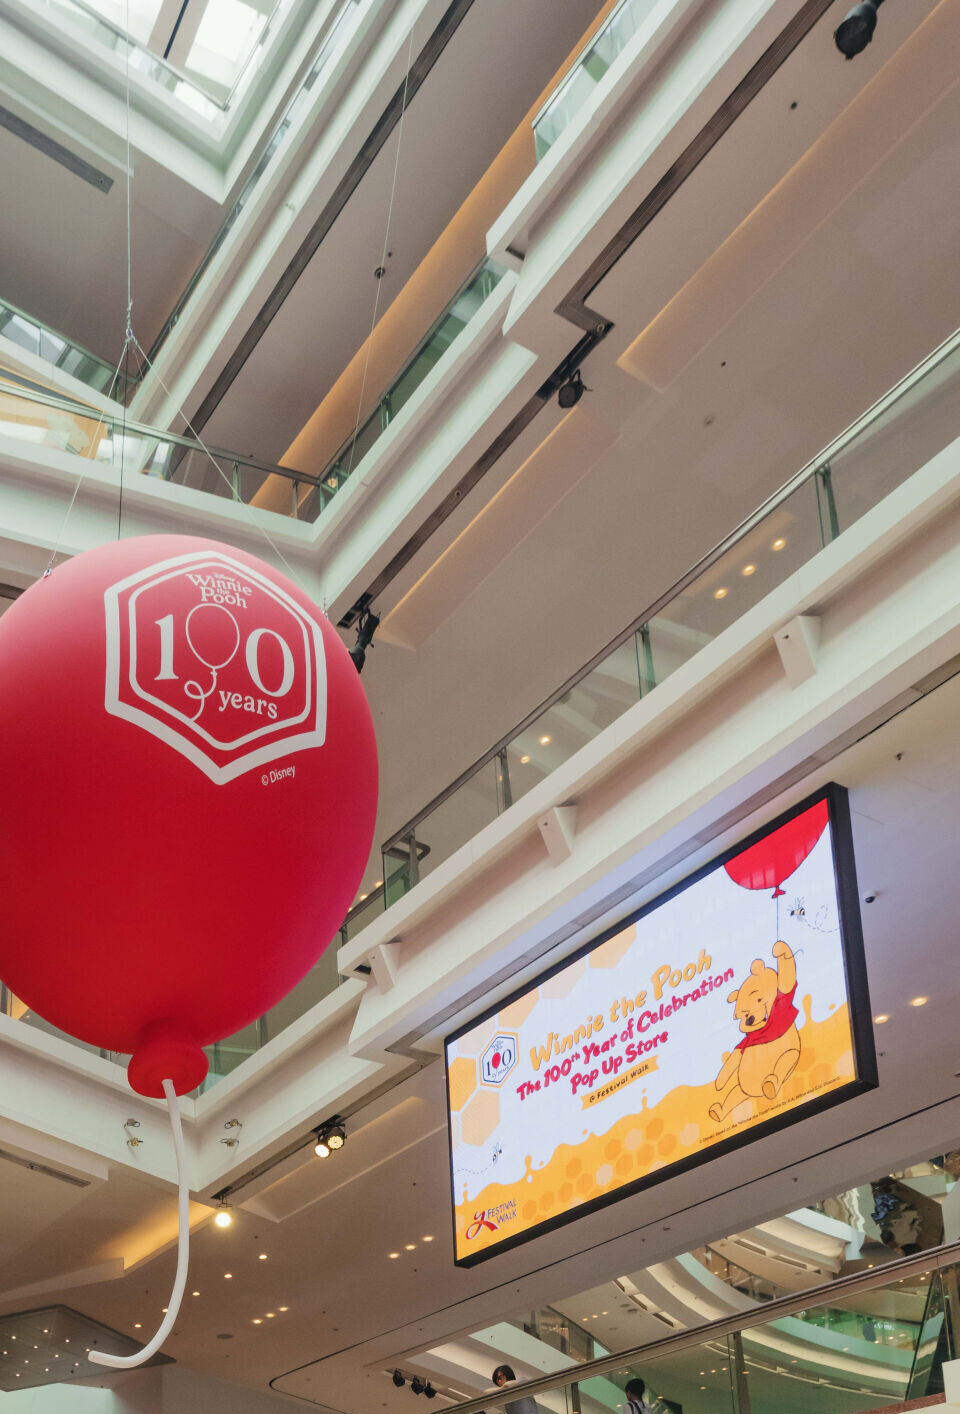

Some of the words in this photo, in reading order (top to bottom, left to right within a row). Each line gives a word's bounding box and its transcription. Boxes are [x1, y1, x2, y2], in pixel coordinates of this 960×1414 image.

[185, 573, 253, 597] Winnie
[200, 586, 247, 609] Pooh
[219, 690, 278, 720] years
[270, 765, 296, 784] Disney
[529, 1014, 604, 1071] Winnie
[609, 990, 647, 1023] the
[650, 949, 712, 1000] Pooh
[516, 1080, 541, 1101] The
[582, 1033, 618, 1064] Year
[620, 1018, 635, 1042] of
[636, 967, 735, 1033] Celebration
[570, 1067, 599, 1095] Pop
[601, 1055, 623, 1076] Up
[625, 1031, 669, 1063] Store
[597, 1075, 629, 1099] Festival
[630, 1063, 650, 1080] Walk
[487, 1198, 516, 1219] FESTIVAL
[496, 1208, 517, 1224] WALK
